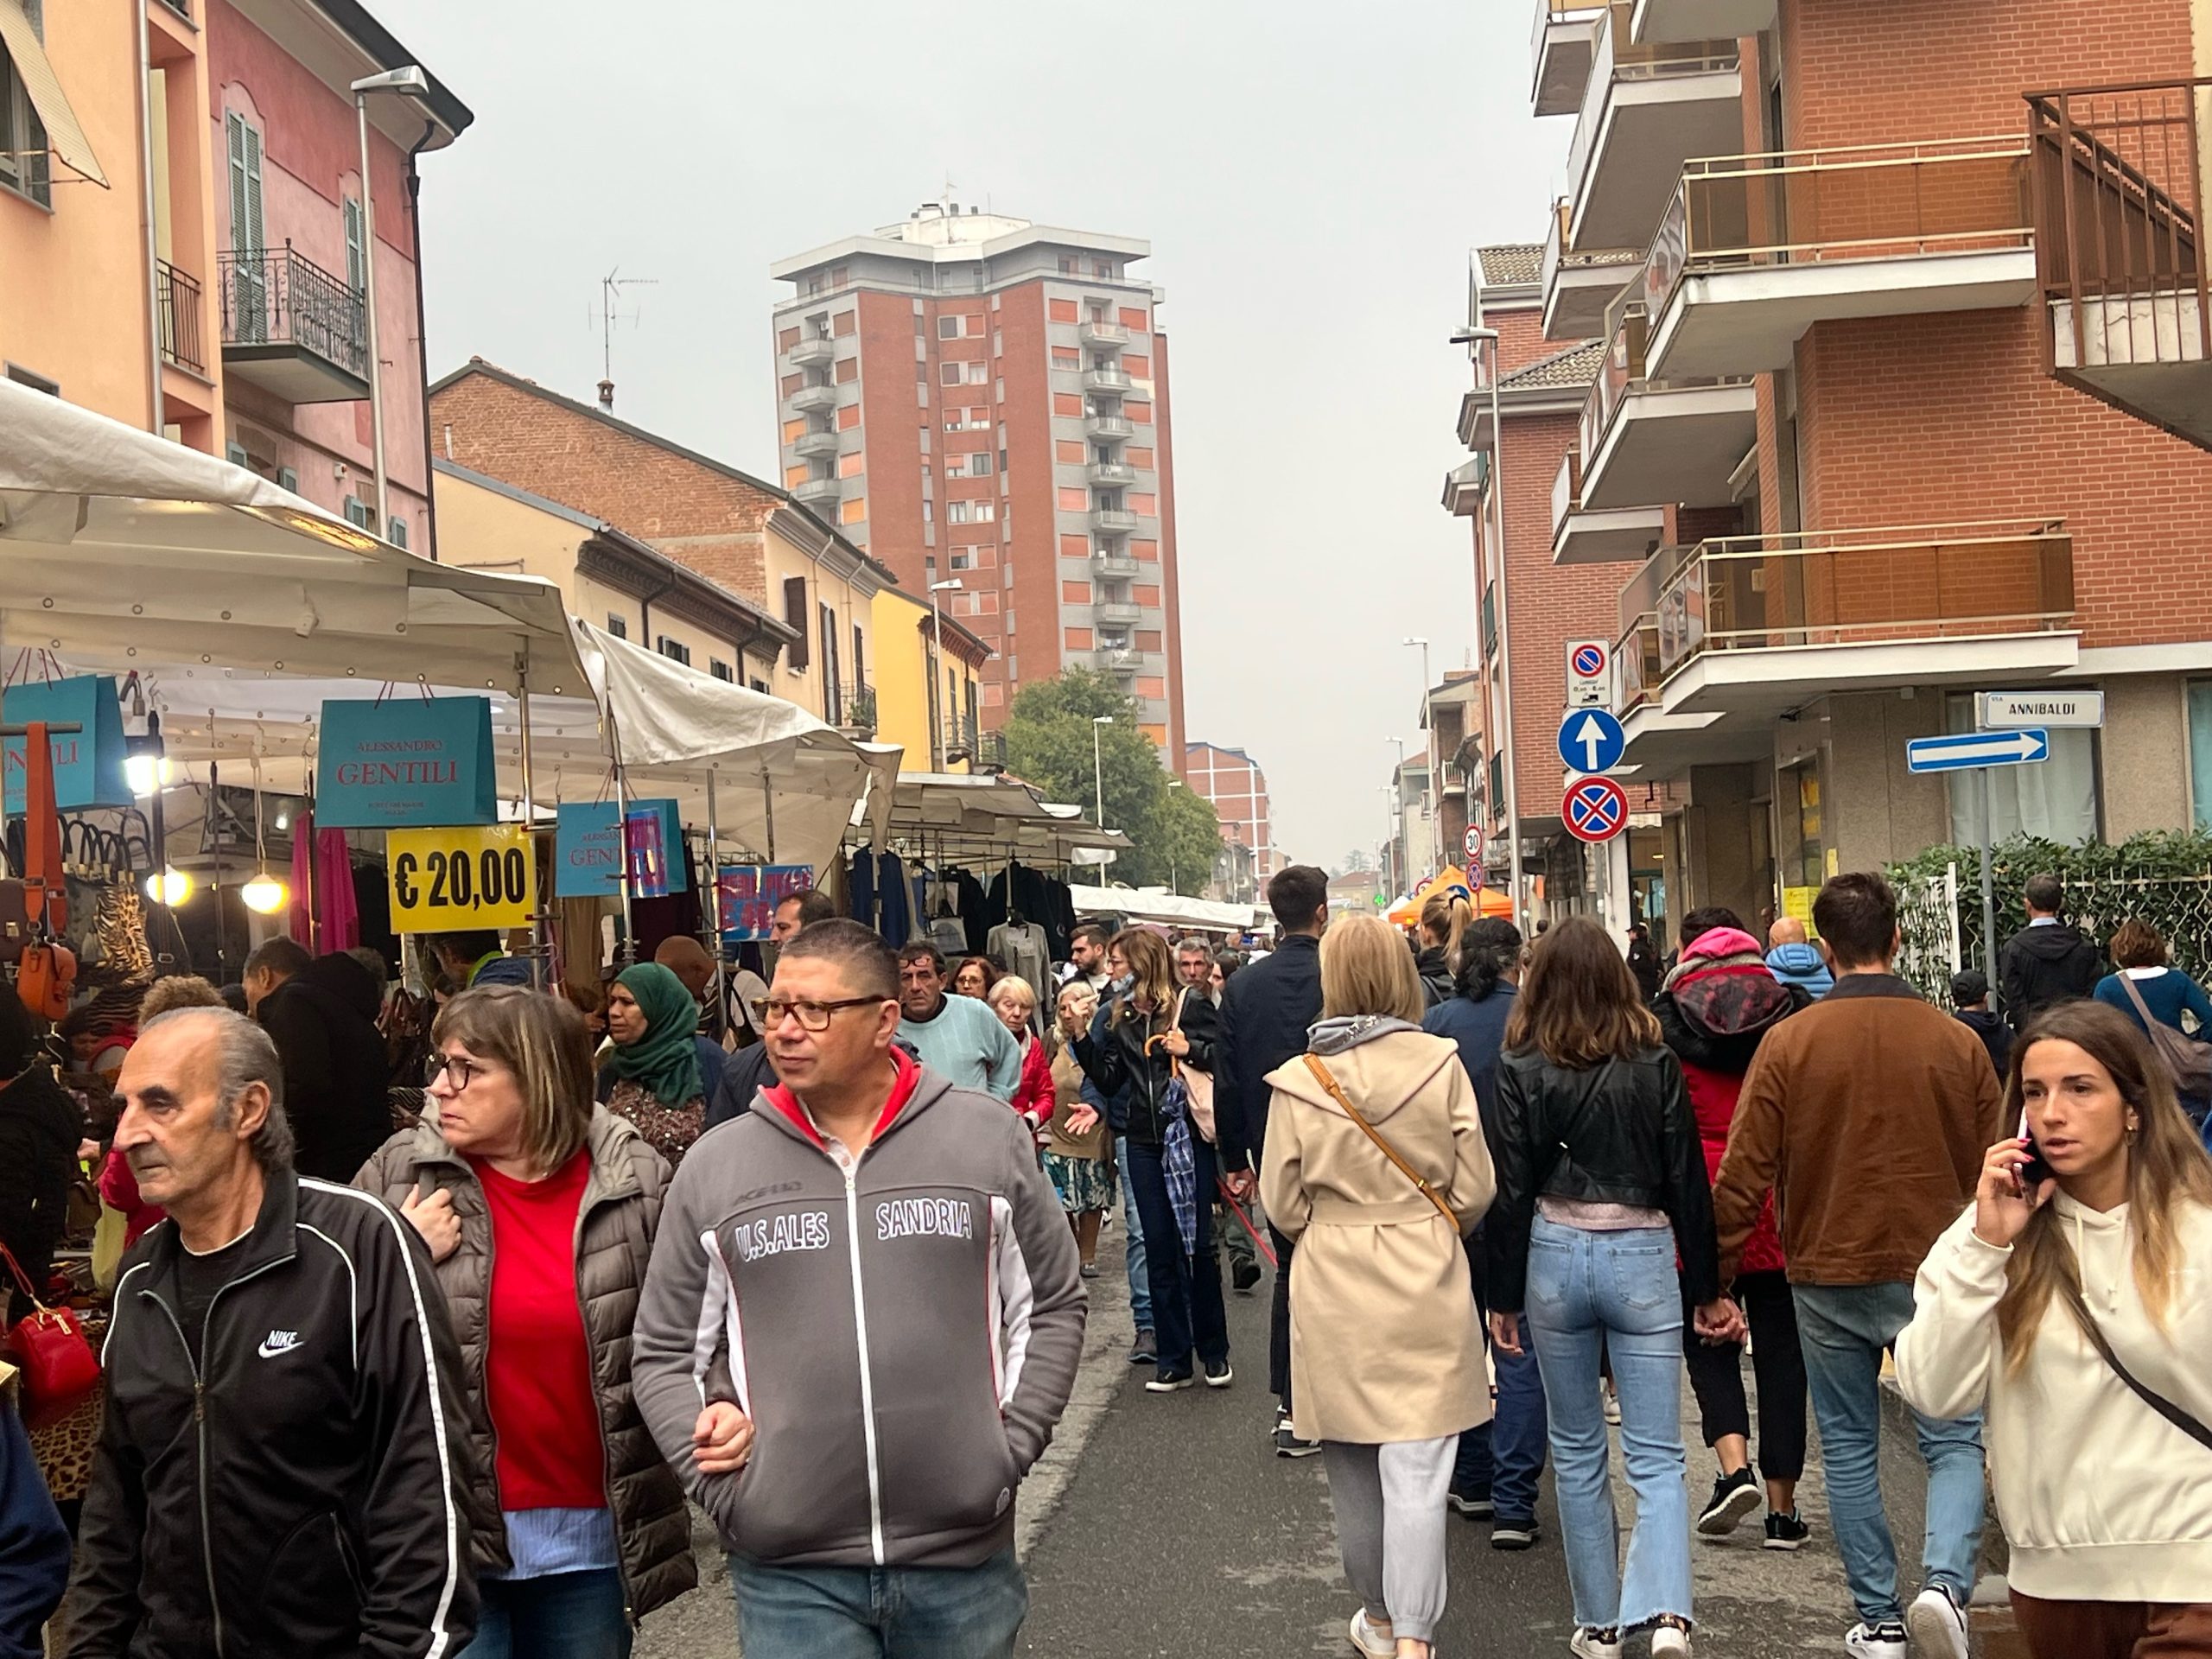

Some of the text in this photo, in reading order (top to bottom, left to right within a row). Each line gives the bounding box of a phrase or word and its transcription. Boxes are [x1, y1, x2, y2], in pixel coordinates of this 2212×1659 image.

[2008, 702, 2076, 715] ANNIBALDI
[358, 740, 442, 753] ALESSANDRO
[336, 760, 458, 786] GENTILI
[1467, 834, 1479, 850] 30
[394, 847, 526, 912] € 20,00
[875, 1198, 972, 1240] SANDRIA
[266, 1329, 298, 1347] NIKE
